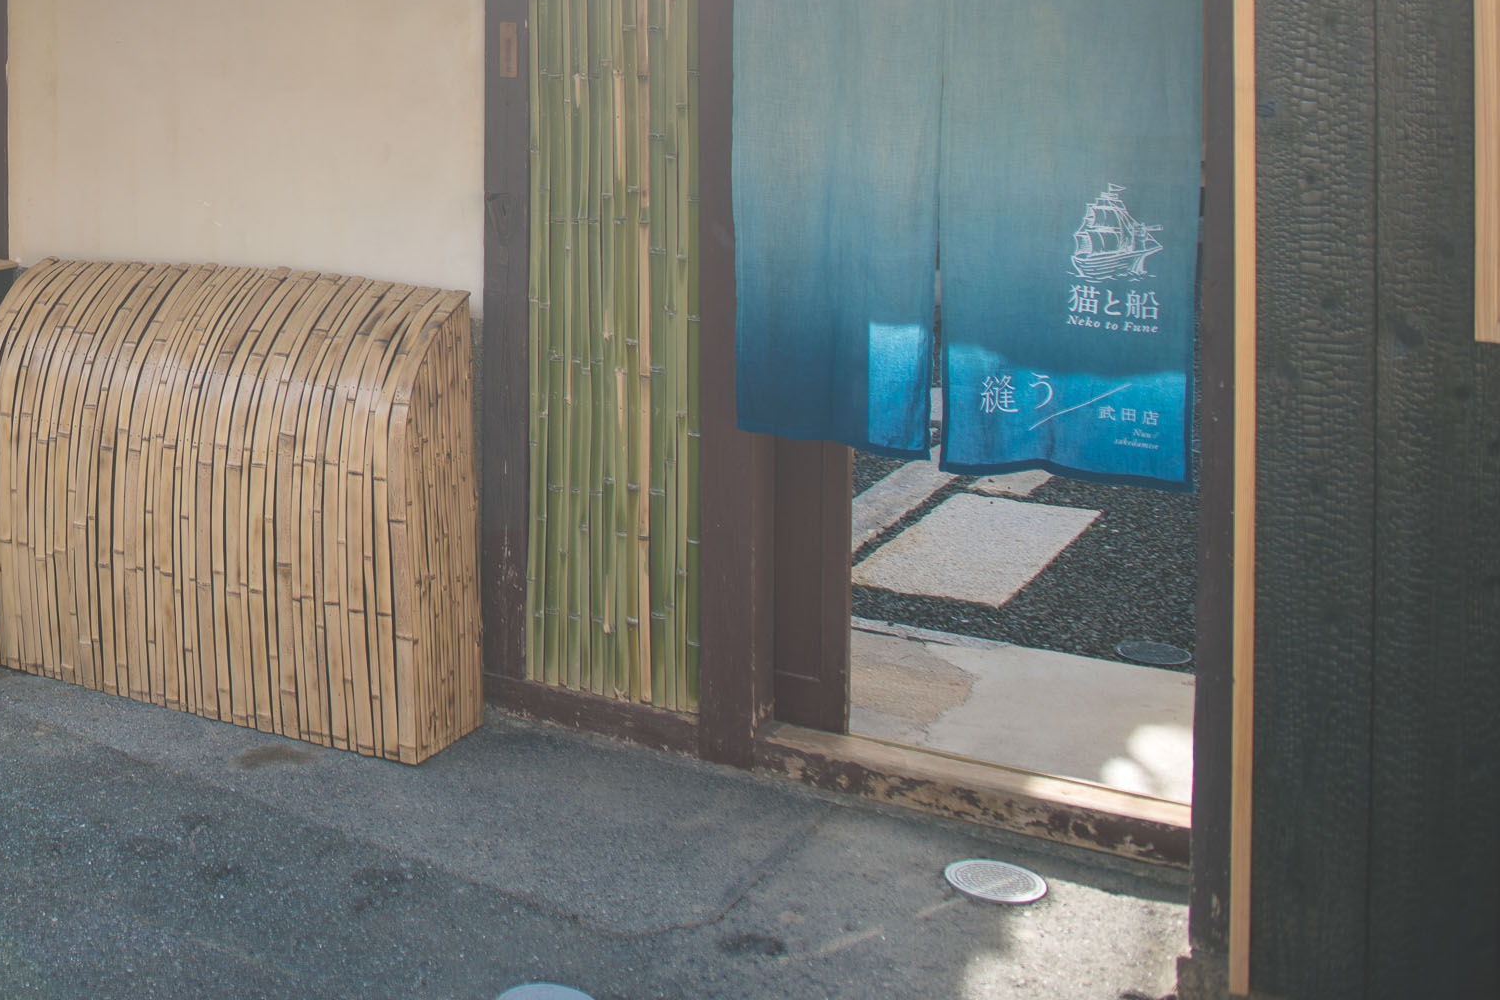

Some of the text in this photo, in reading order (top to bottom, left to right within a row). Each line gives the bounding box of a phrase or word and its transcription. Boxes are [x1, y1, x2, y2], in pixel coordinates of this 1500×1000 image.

[1068, 284, 1160, 320] 猫と船
[1066, 314, 1159, 333] Neko to Fune
[980, 372, 1053, 413] 縫う
[1099, 405, 1160, 426] 武田店
